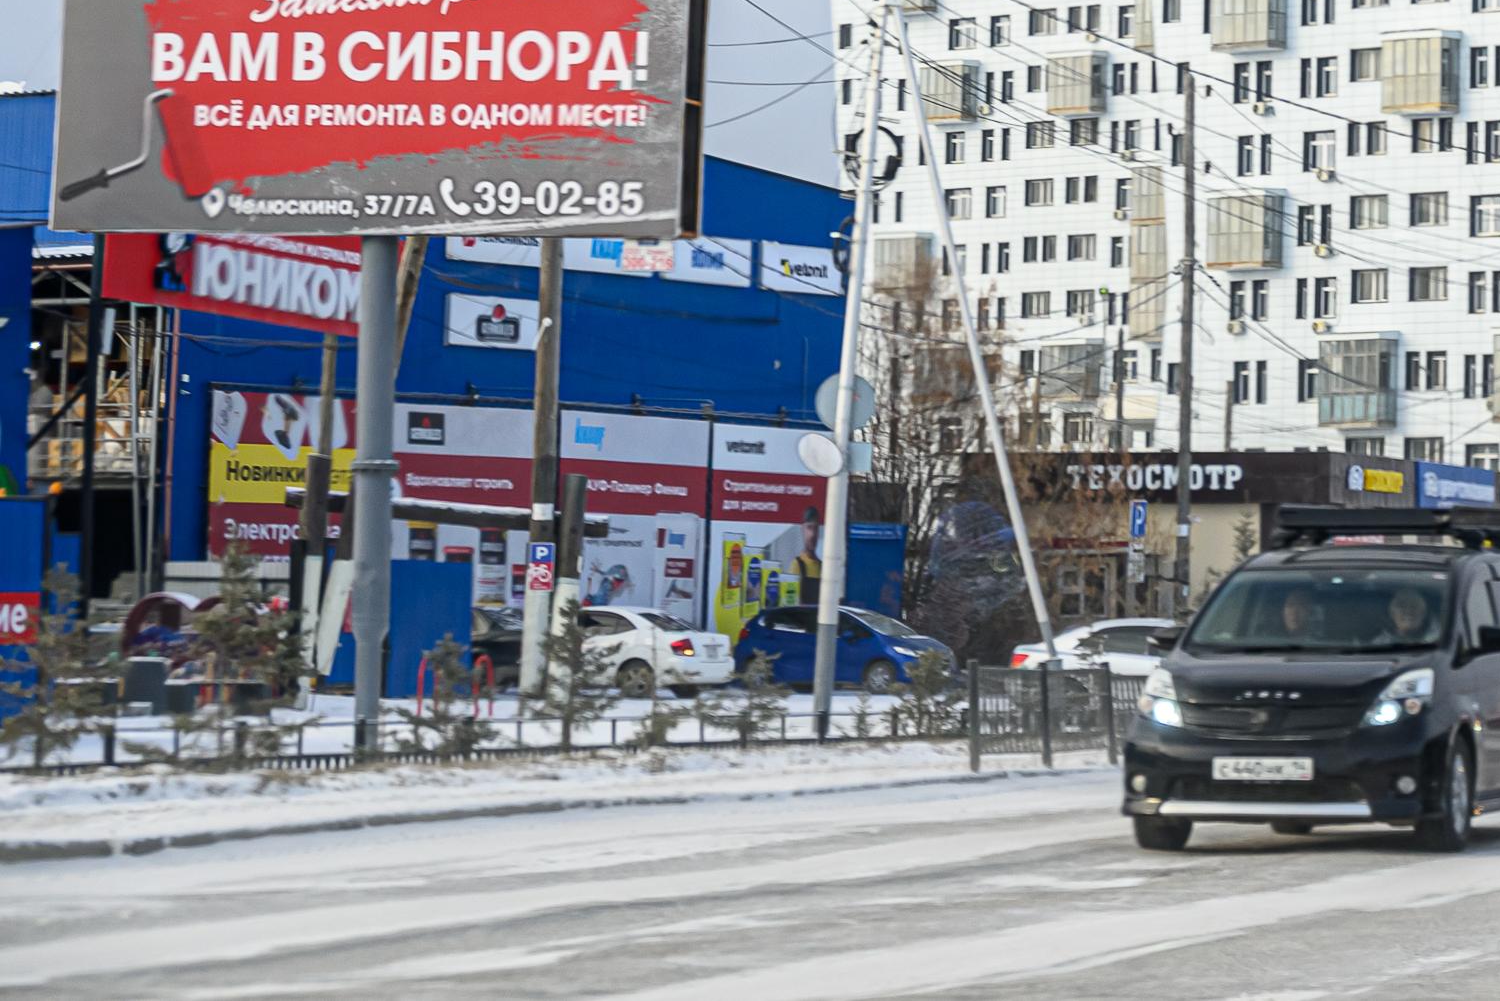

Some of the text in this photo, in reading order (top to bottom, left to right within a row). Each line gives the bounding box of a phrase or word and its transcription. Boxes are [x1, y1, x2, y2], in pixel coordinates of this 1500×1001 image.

[152, 30, 649, 91] ВАМ В СИБНОРД!
[193, 99, 647, 130] ВСЁ ДЛЯ РЕМОНТА В ОДНОМ МЕСТЕ!
[227, 194, 359, 218] Челюскина,
[472, 181, 644, 216] 39-02-85
[192, 241, 362, 322] ЮНИКОМ
[226, 460, 305, 482] Новинки
